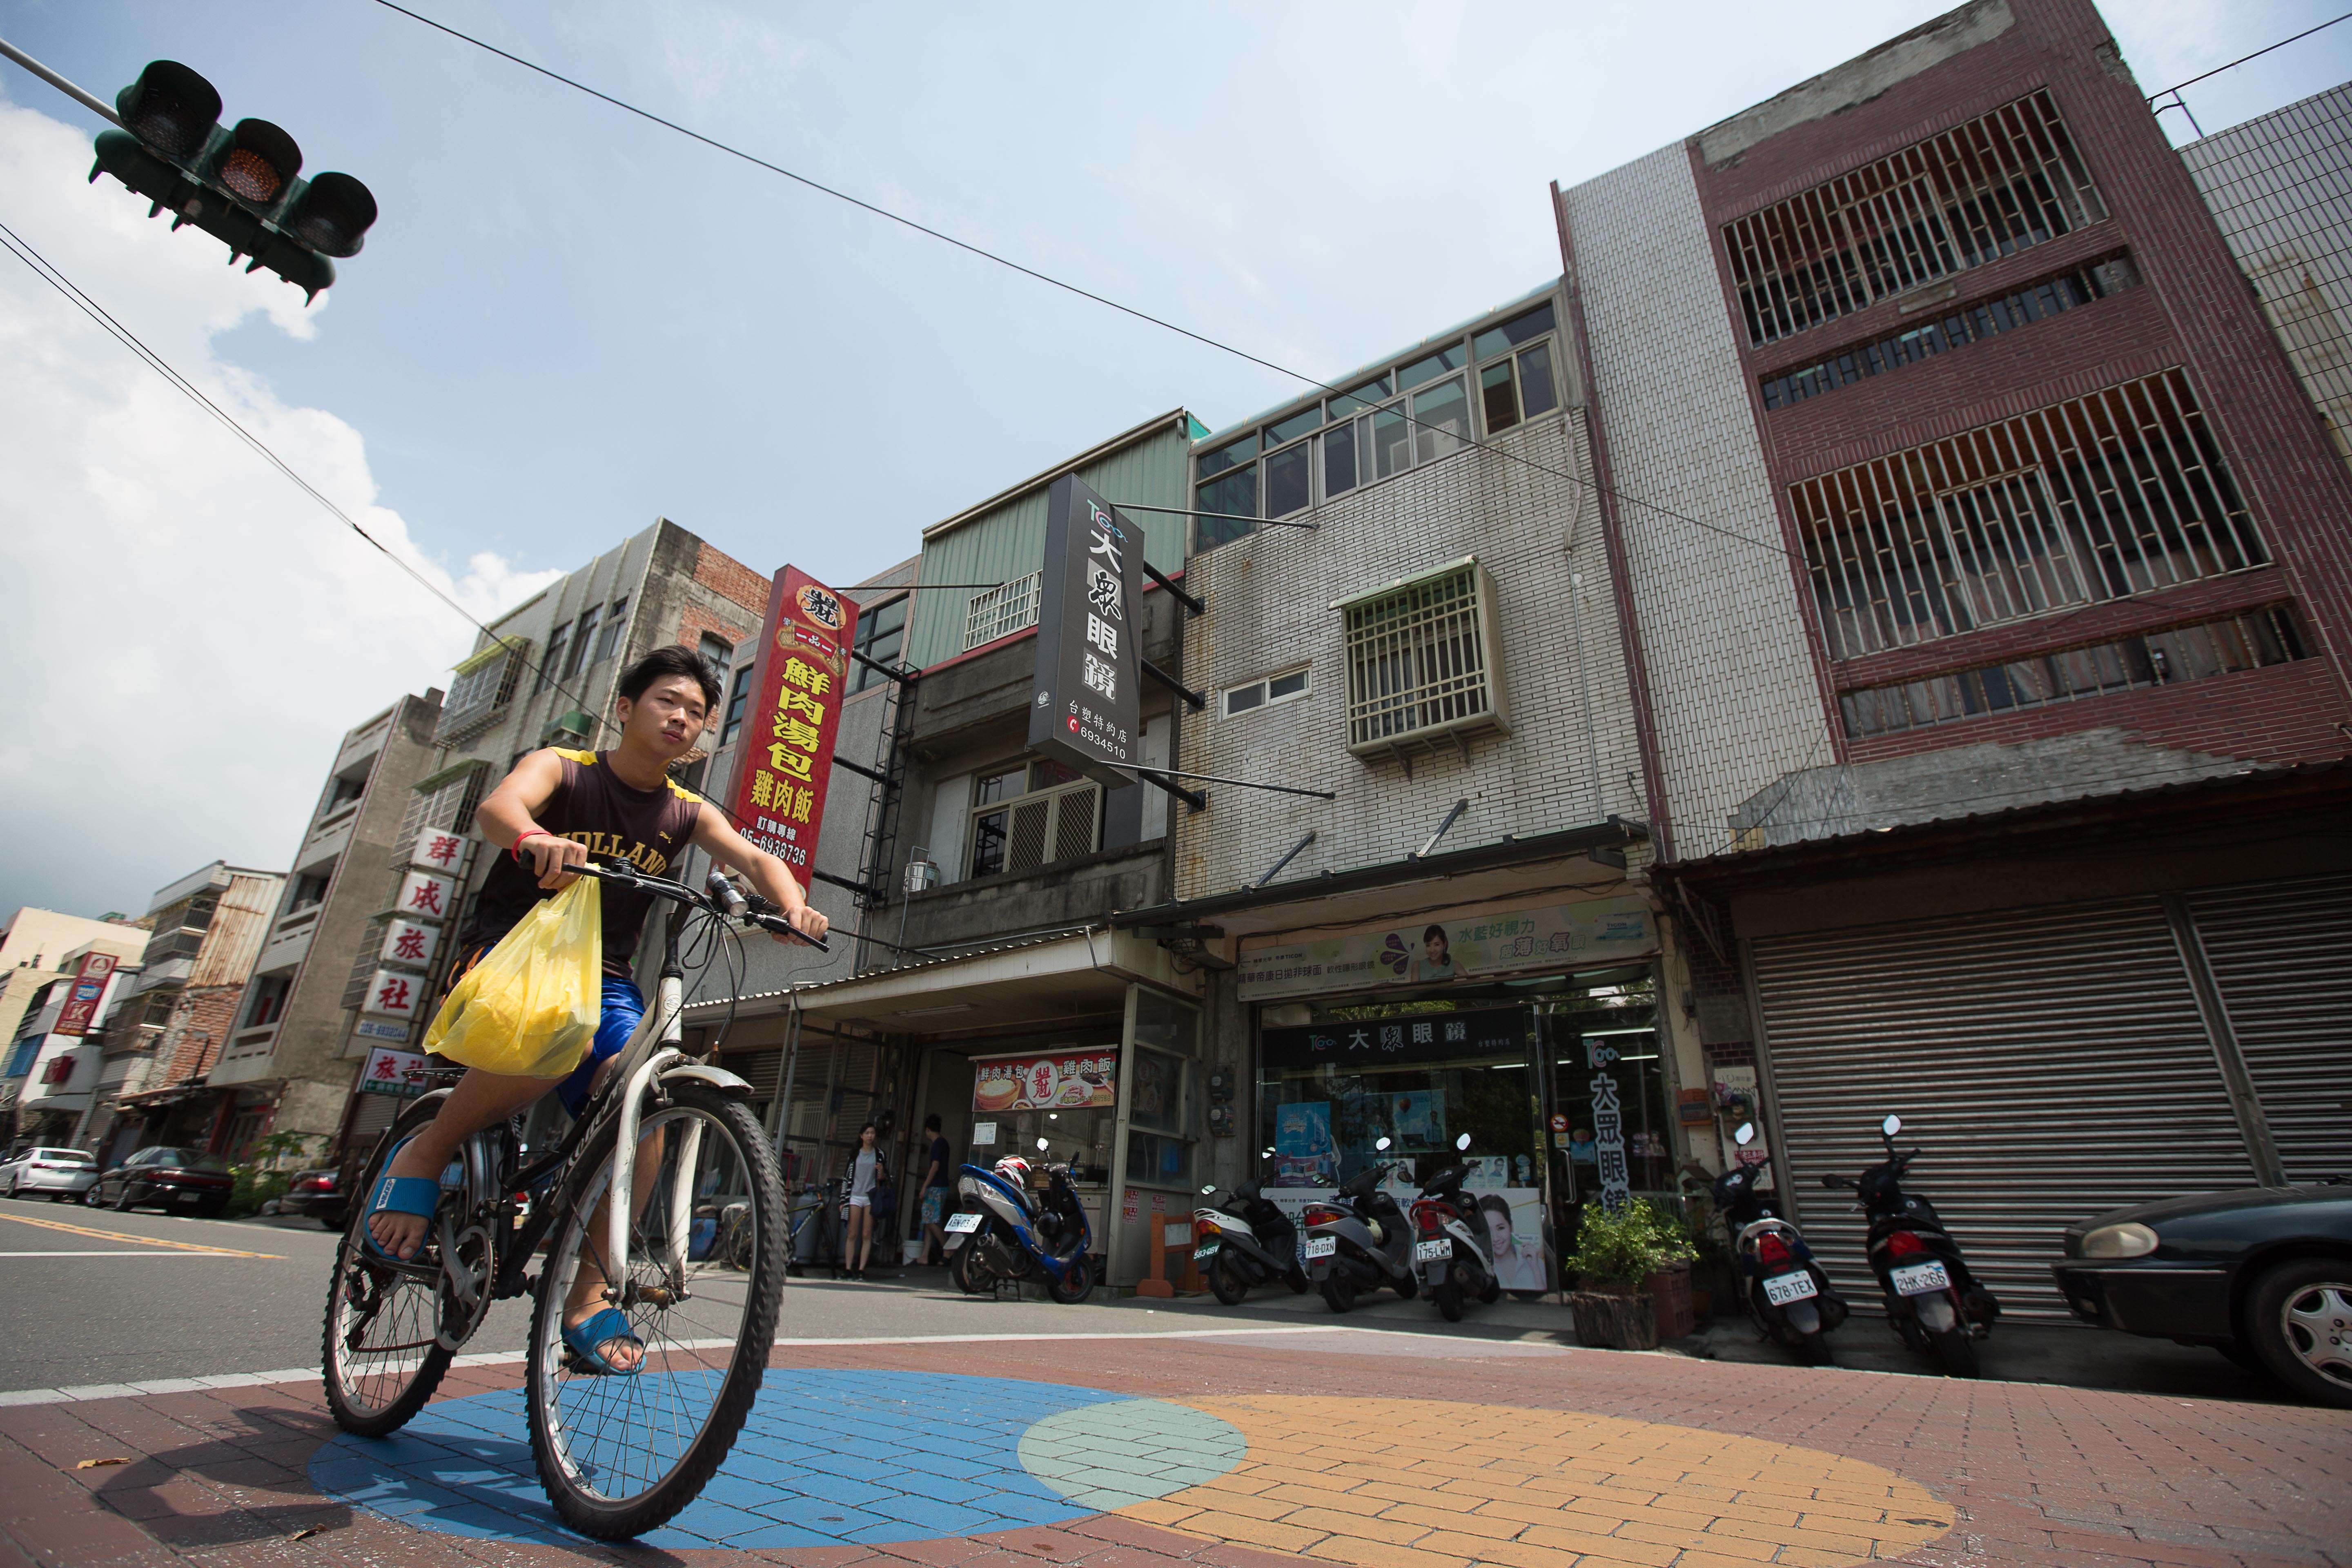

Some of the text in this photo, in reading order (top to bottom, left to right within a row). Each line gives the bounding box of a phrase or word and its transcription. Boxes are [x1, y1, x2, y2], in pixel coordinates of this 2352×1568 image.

[766, 656, 831, 782] 鮮肉湯包
[1069, 700, 1127, 744] 台塑特約店
[1081, 726, 1126, 760] 6934510
[750, 768, 813, 824] 雞肉飯
[757, 816, 796, 841] 訂購專線
[379, 836, 460, 1010] 群成旅社
[980, 1065, 1024, 1080] 鮮肉湯包
[1063, 1057, 1111, 1076] 雞肉飯
[1307, 1242, 1334, 1255] 718-DXN
[1419, 1245, 1451, 1259] 175-LWM
[1769, 1279, 1815, 1301] 678-TEX
